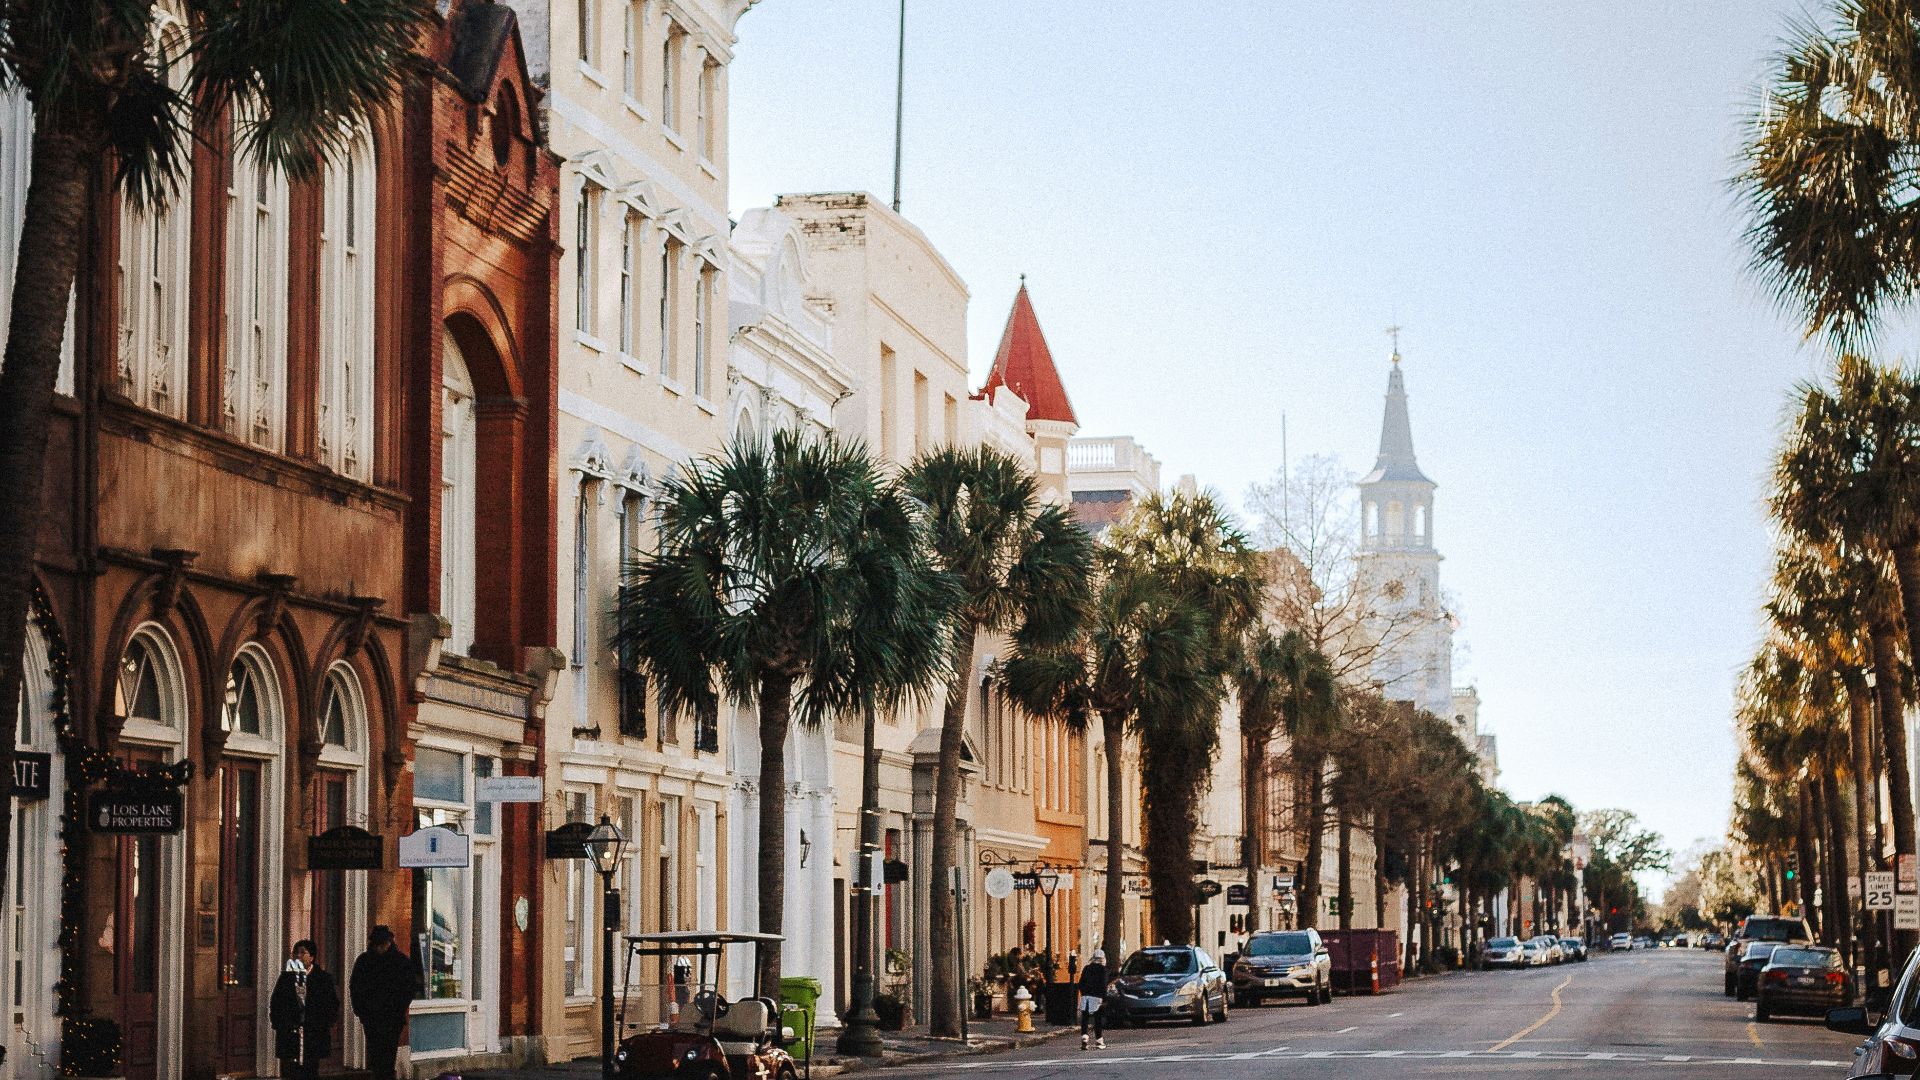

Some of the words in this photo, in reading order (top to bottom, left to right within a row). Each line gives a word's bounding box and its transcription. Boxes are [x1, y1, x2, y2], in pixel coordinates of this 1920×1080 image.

[113, 804, 139, 816] LOIS
[142, 804, 172, 816] LANE
[112, 817, 172, 827] PROPERTIES
[1869, 892, 1892, 905] 25
